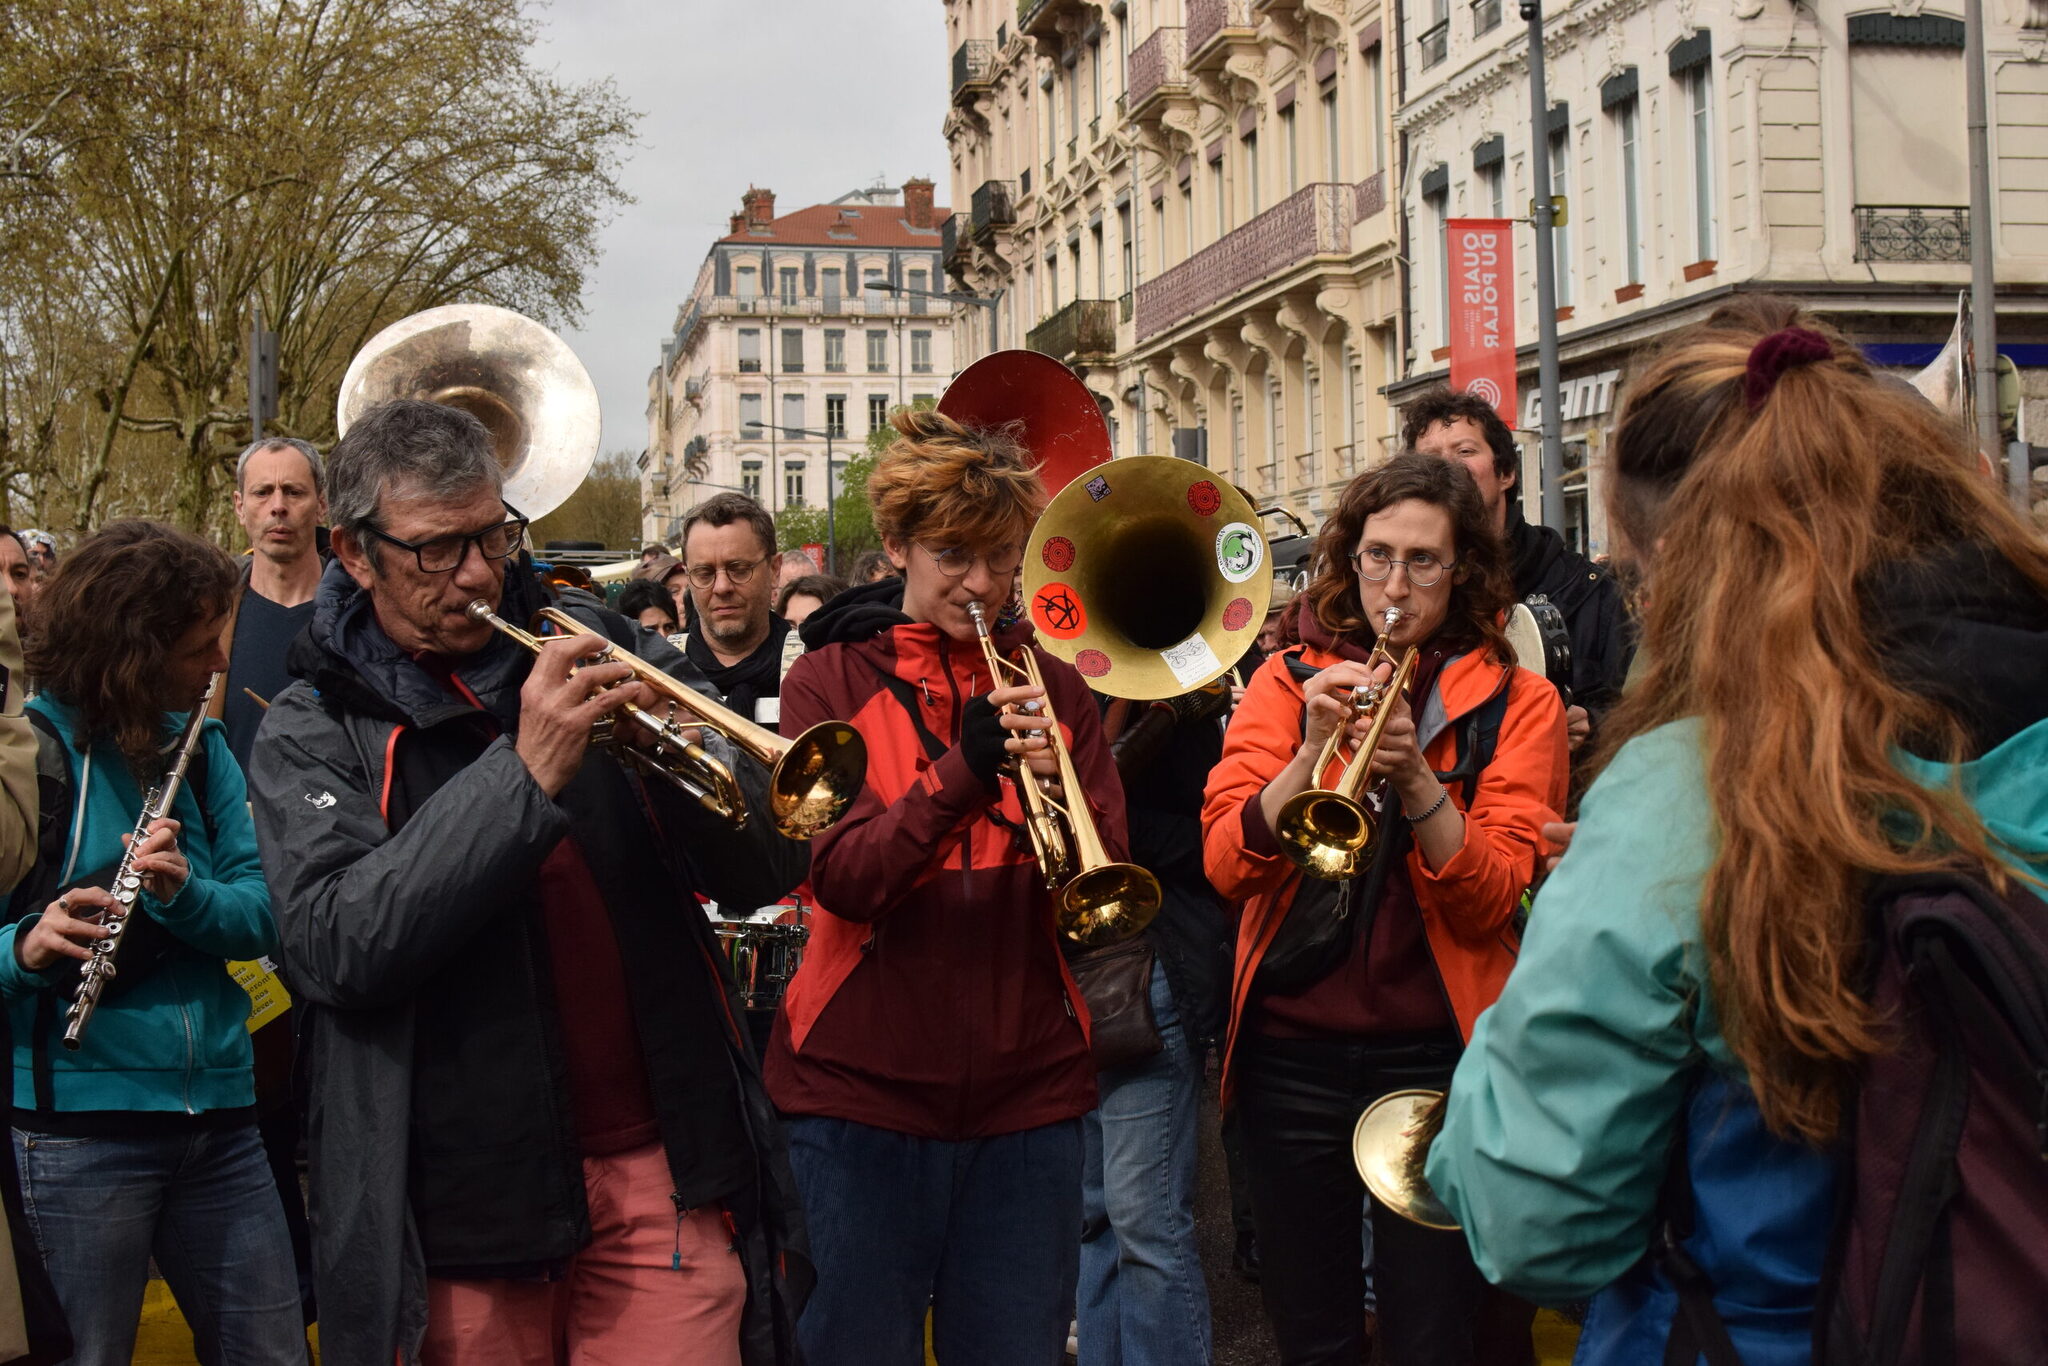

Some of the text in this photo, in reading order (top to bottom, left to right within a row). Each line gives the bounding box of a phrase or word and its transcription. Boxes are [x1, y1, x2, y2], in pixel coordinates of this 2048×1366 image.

[1524, 369, 1620, 428] GANT
[232, 966, 247, 977] urs
[238, 973, 256, 985] chts
[254, 988, 269, 1001] nos
